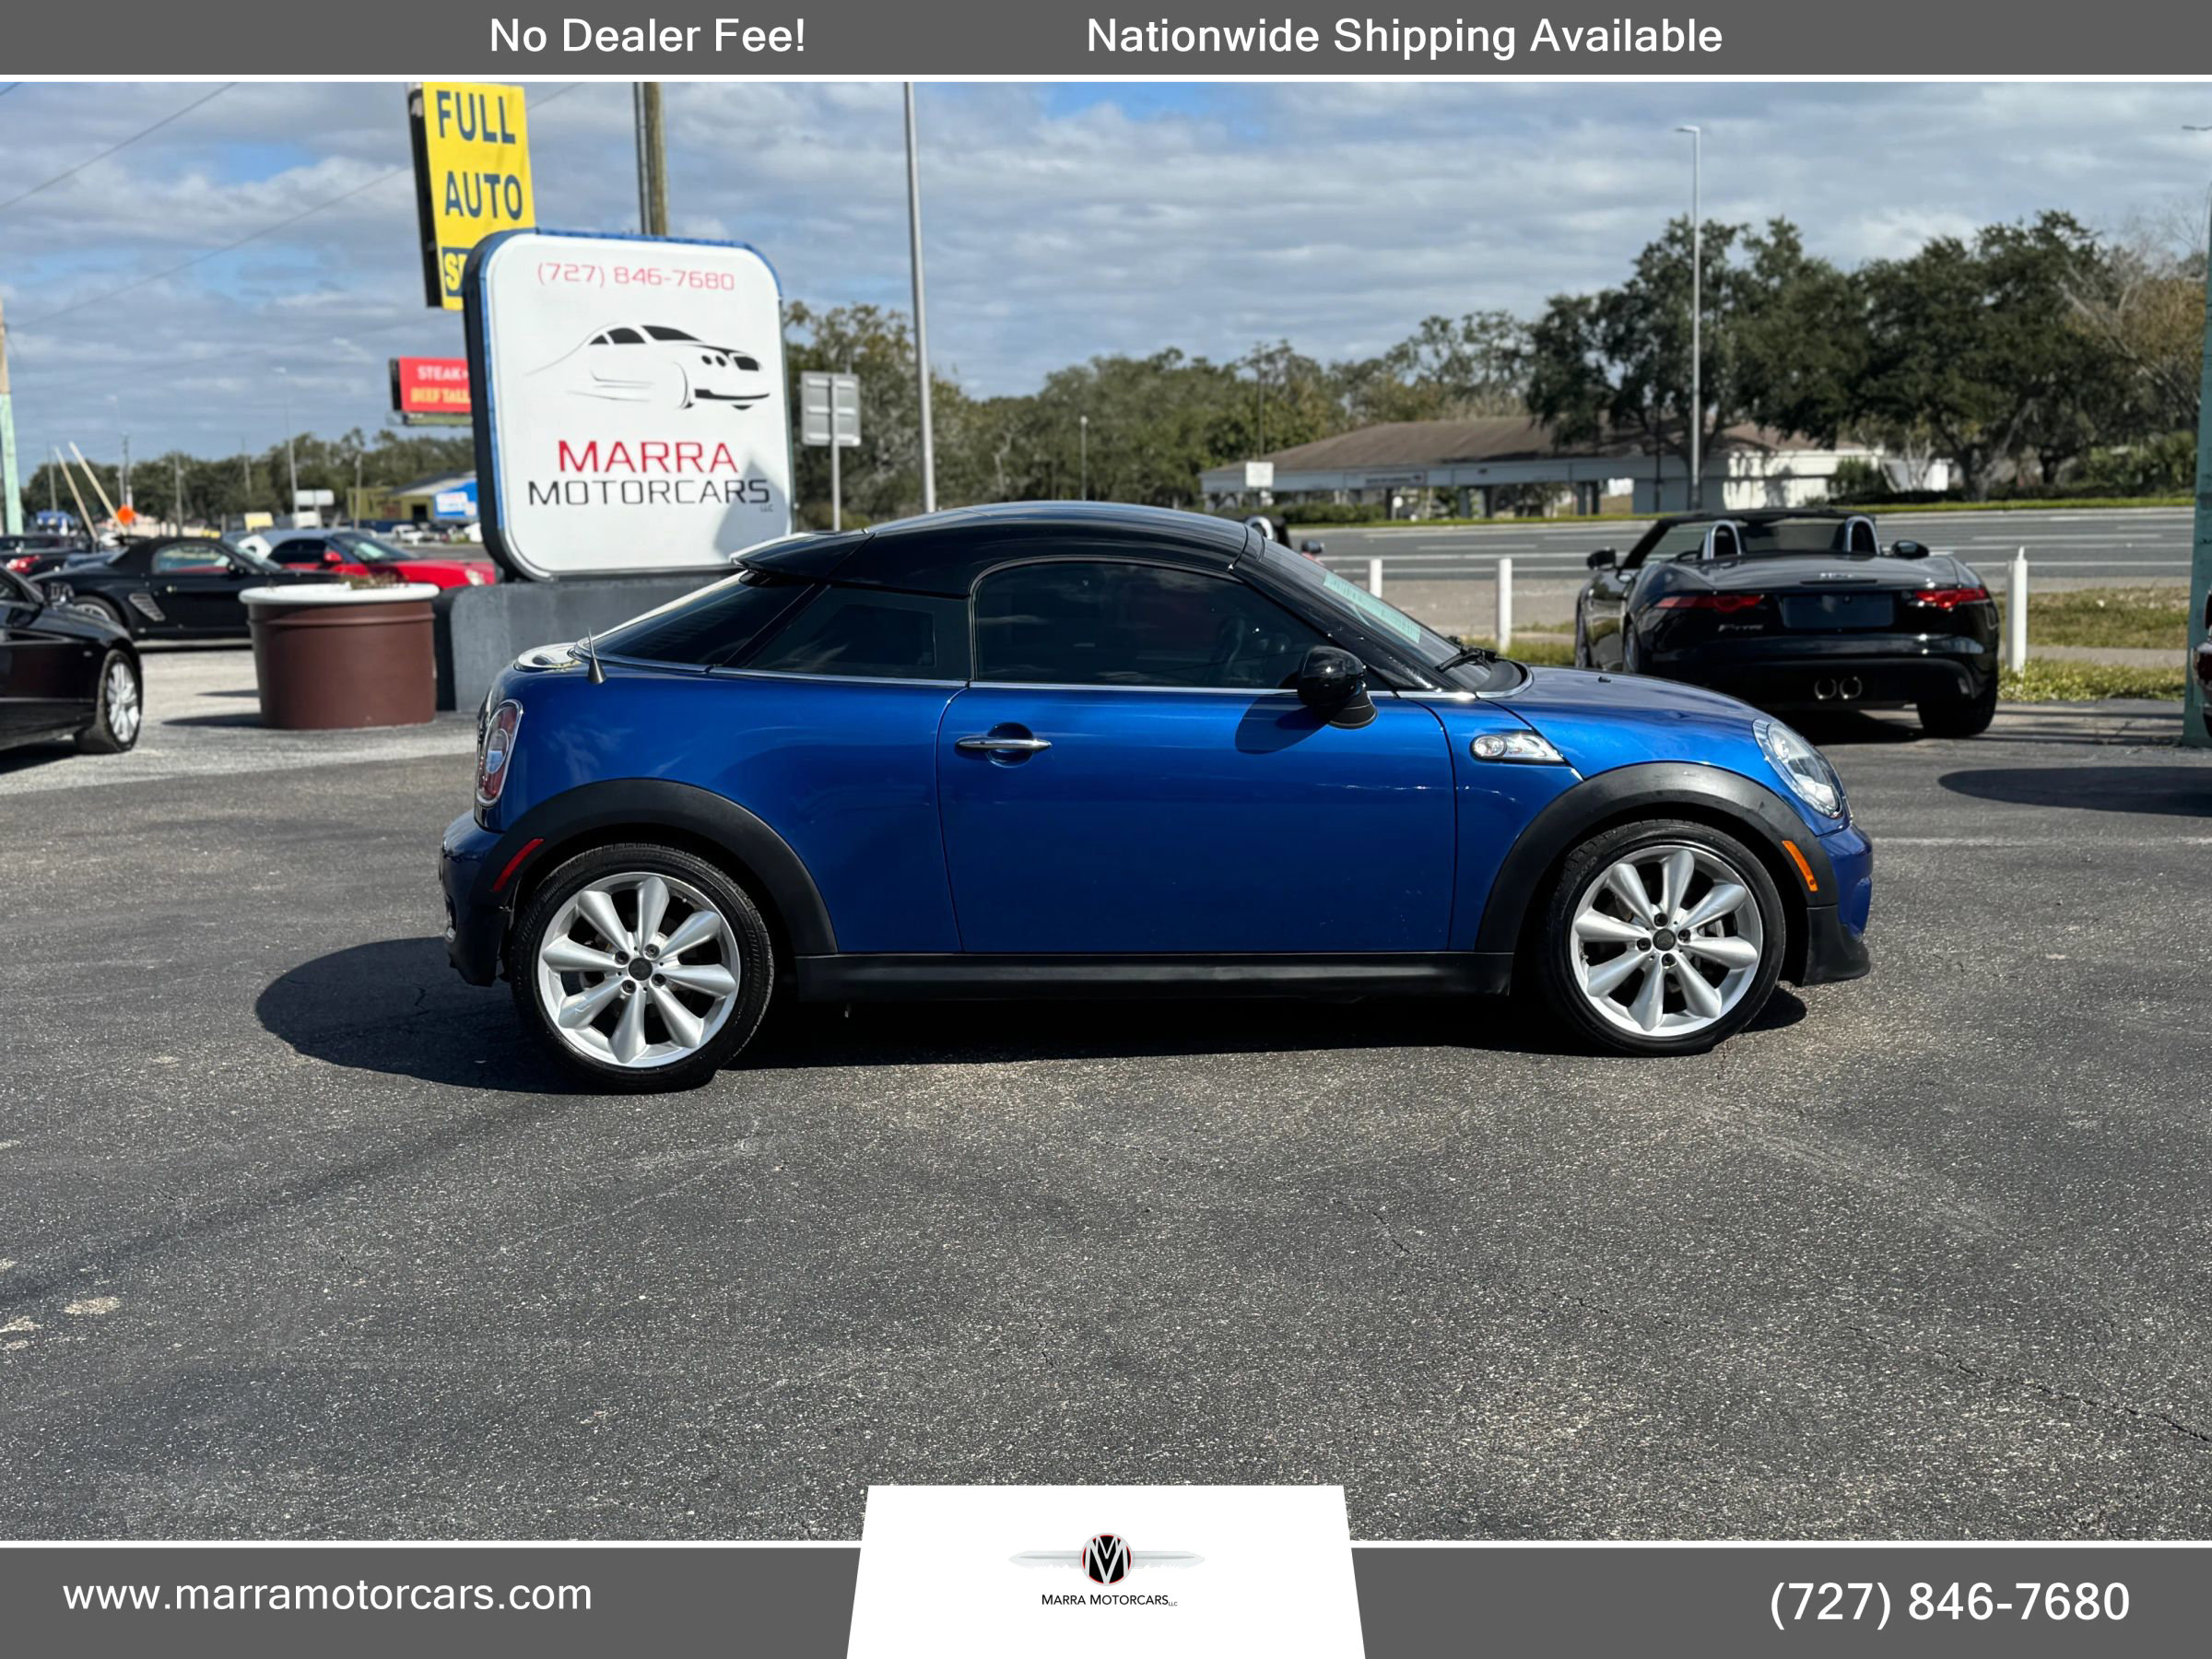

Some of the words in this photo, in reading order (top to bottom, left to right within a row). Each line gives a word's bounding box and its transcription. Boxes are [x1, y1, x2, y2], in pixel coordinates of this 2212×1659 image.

[436, 89, 516, 145] FULL
[445, 171, 523, 221] AUTO
[537, 262, 606, 288] (727)
[614, 266, 735, 291] 846-7680
[558, 440, 738, 473] MARRA
[528, 479, 771, 506] MOTORCARS
